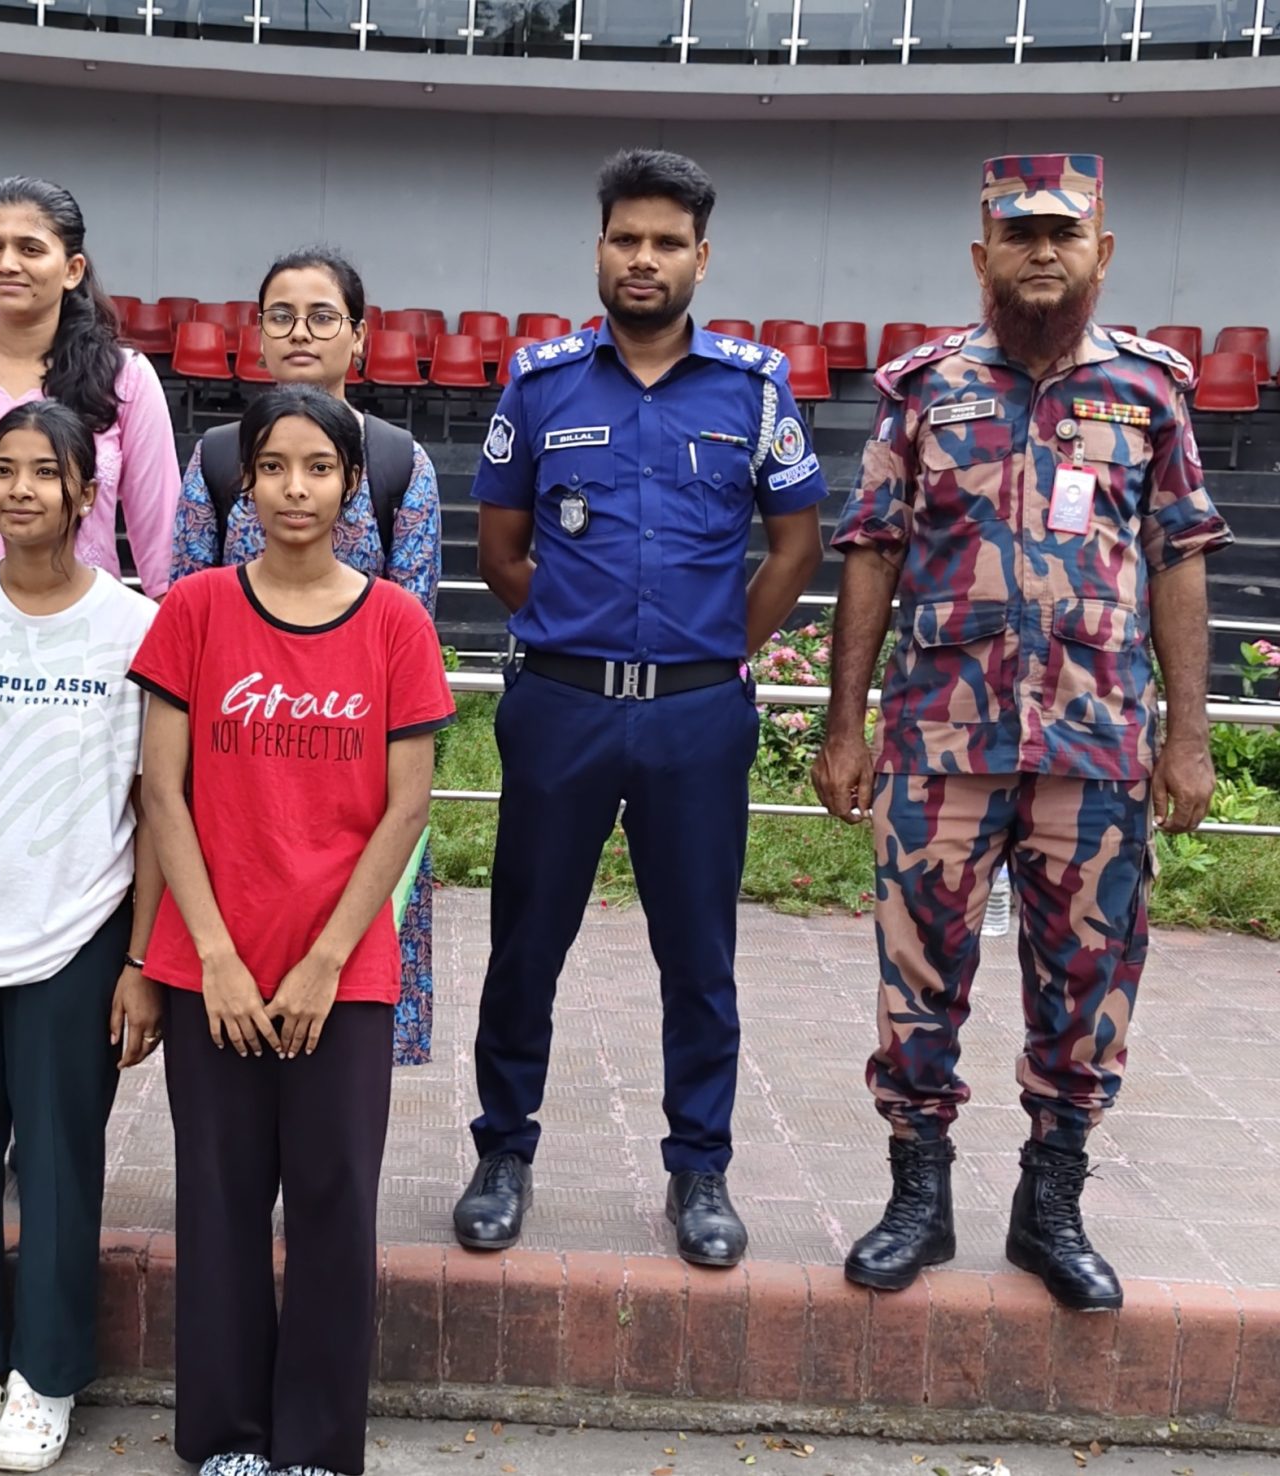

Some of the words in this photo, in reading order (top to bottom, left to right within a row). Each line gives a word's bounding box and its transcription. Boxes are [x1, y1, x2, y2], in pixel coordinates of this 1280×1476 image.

[515, 346, 532, 375] POLICE
[762, 348, 786, 376] POLICE
[560, 433, 594, 443] BILLAL
[24, 697, 89, 707] COMPANY
[54, 678, 112, 698] ASSN.
[221, 671, 372, 728] Grace
[211, 719, 243, 755] NOT
[251, 721, 365, 761] PERFECTION
